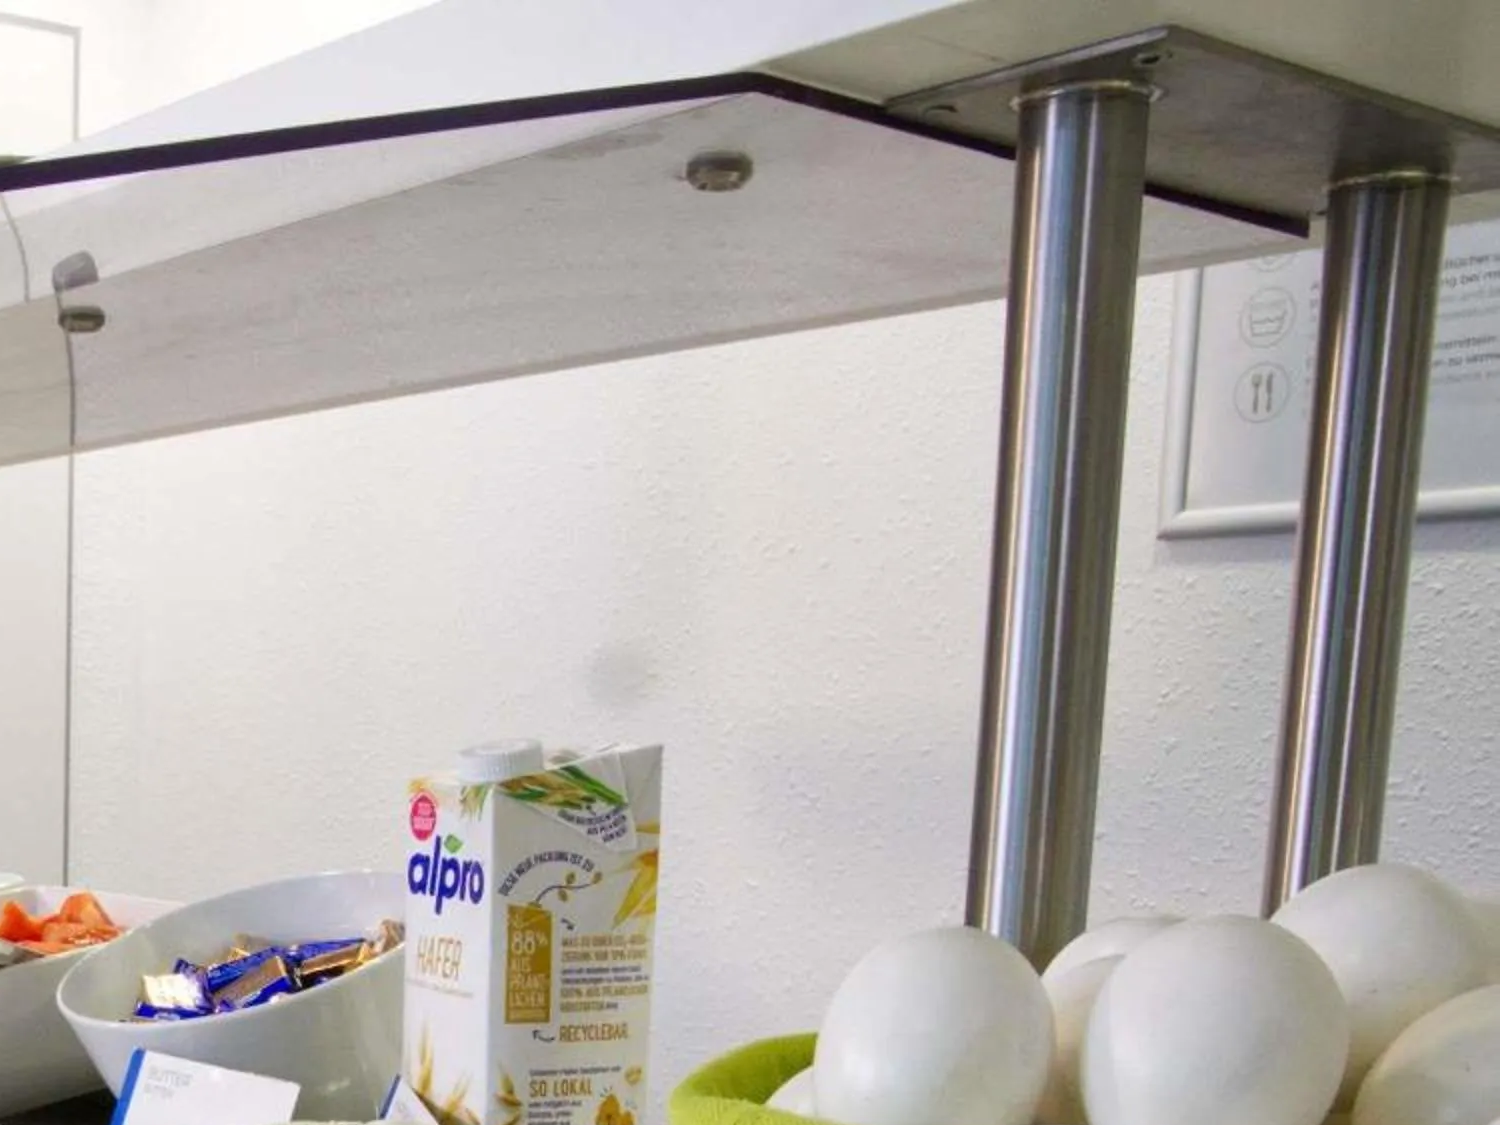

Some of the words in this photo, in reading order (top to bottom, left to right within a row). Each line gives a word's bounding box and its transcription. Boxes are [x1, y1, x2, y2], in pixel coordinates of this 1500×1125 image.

[407, 835, 484, 915] alpro
[418, 934, 463, 981] HAFER
[529, 1081, 547, 1098] SO
[553, 1079, 593, 1097] LOKAL
